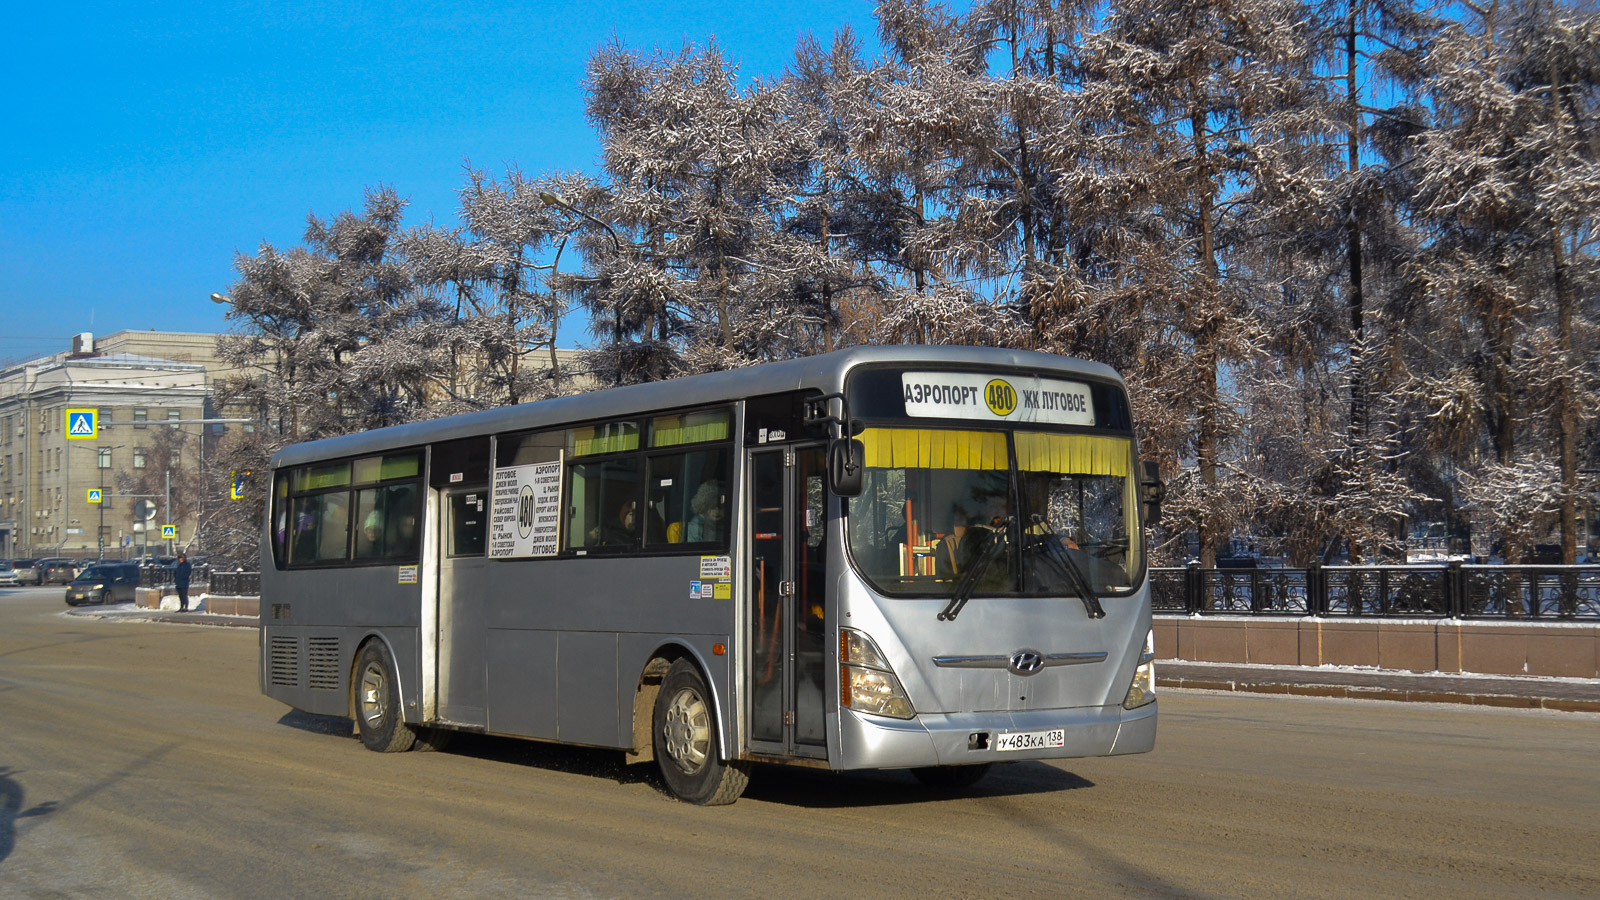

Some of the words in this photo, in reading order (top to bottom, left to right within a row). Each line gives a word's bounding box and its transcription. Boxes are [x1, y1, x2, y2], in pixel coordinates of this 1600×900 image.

[905, 384, 978, 405] АЭРОПОРТ
[988, 385, 1012, 410] 480
[1022, 390, 1040, 408] ЖК
[1042, 391, 1086, 412] ЛУГОВОЕ
[496, 470, 516, 480] ЛУГОВОЕ
[536, 464, 560, 474] АЭРОПОРТ
[520, 495, 533, 528] 480
[532, 545, 556, 554] ЛУГОВОЕ
[1002, 734, 1044, 748] У483КА
[1047, 732, 1062, 742] 138
